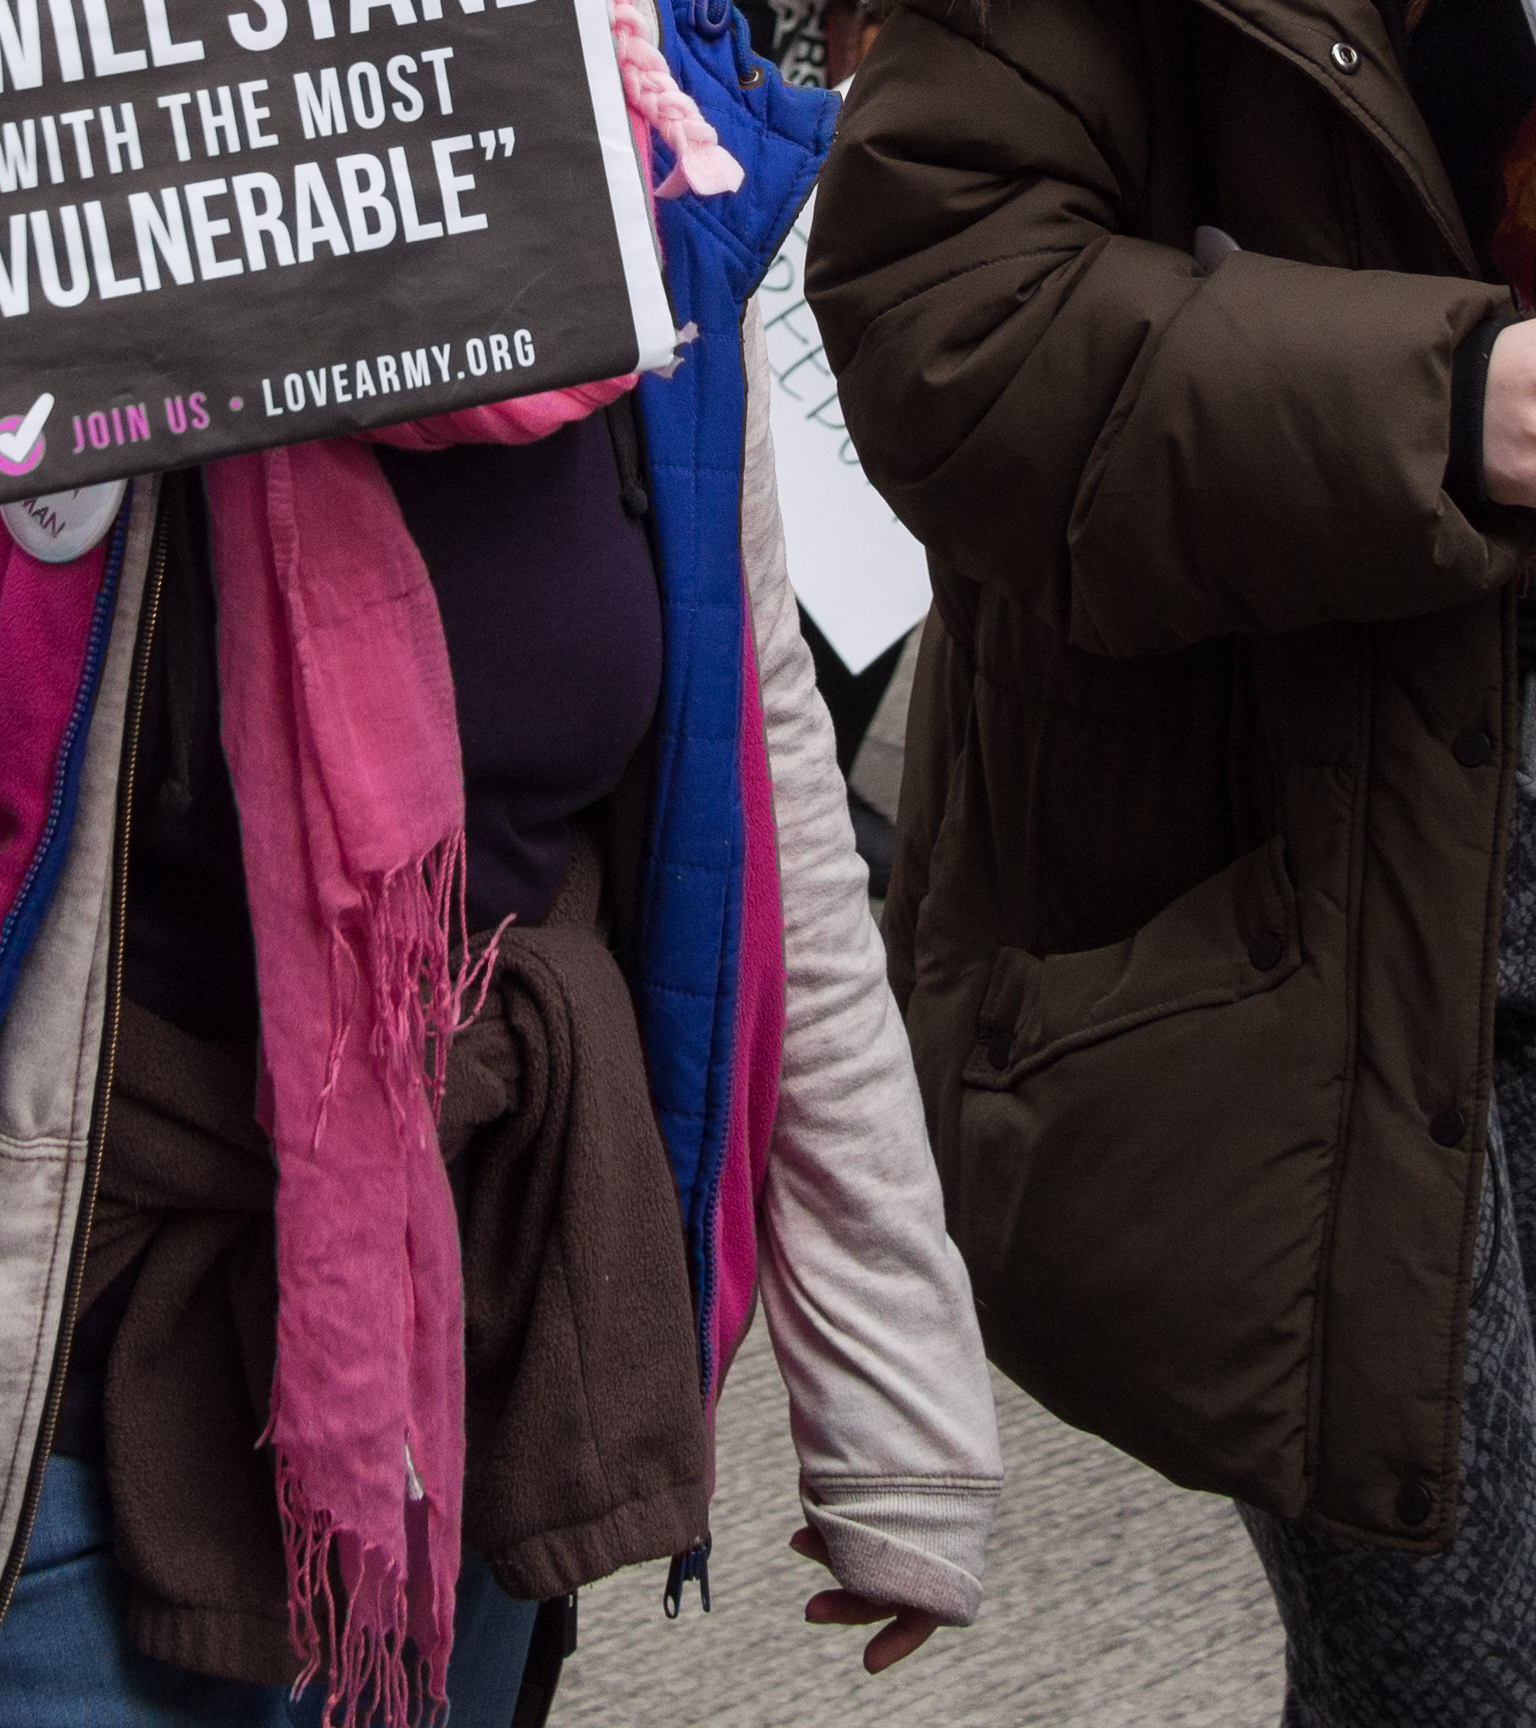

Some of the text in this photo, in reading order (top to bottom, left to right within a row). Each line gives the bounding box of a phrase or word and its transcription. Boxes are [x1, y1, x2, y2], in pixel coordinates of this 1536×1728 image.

[158, 78, 280, 162] THE
[295, 46, 455, 142] MOST
[72, 328, 537, 454] JOIN US LOVEARMY.ORG
